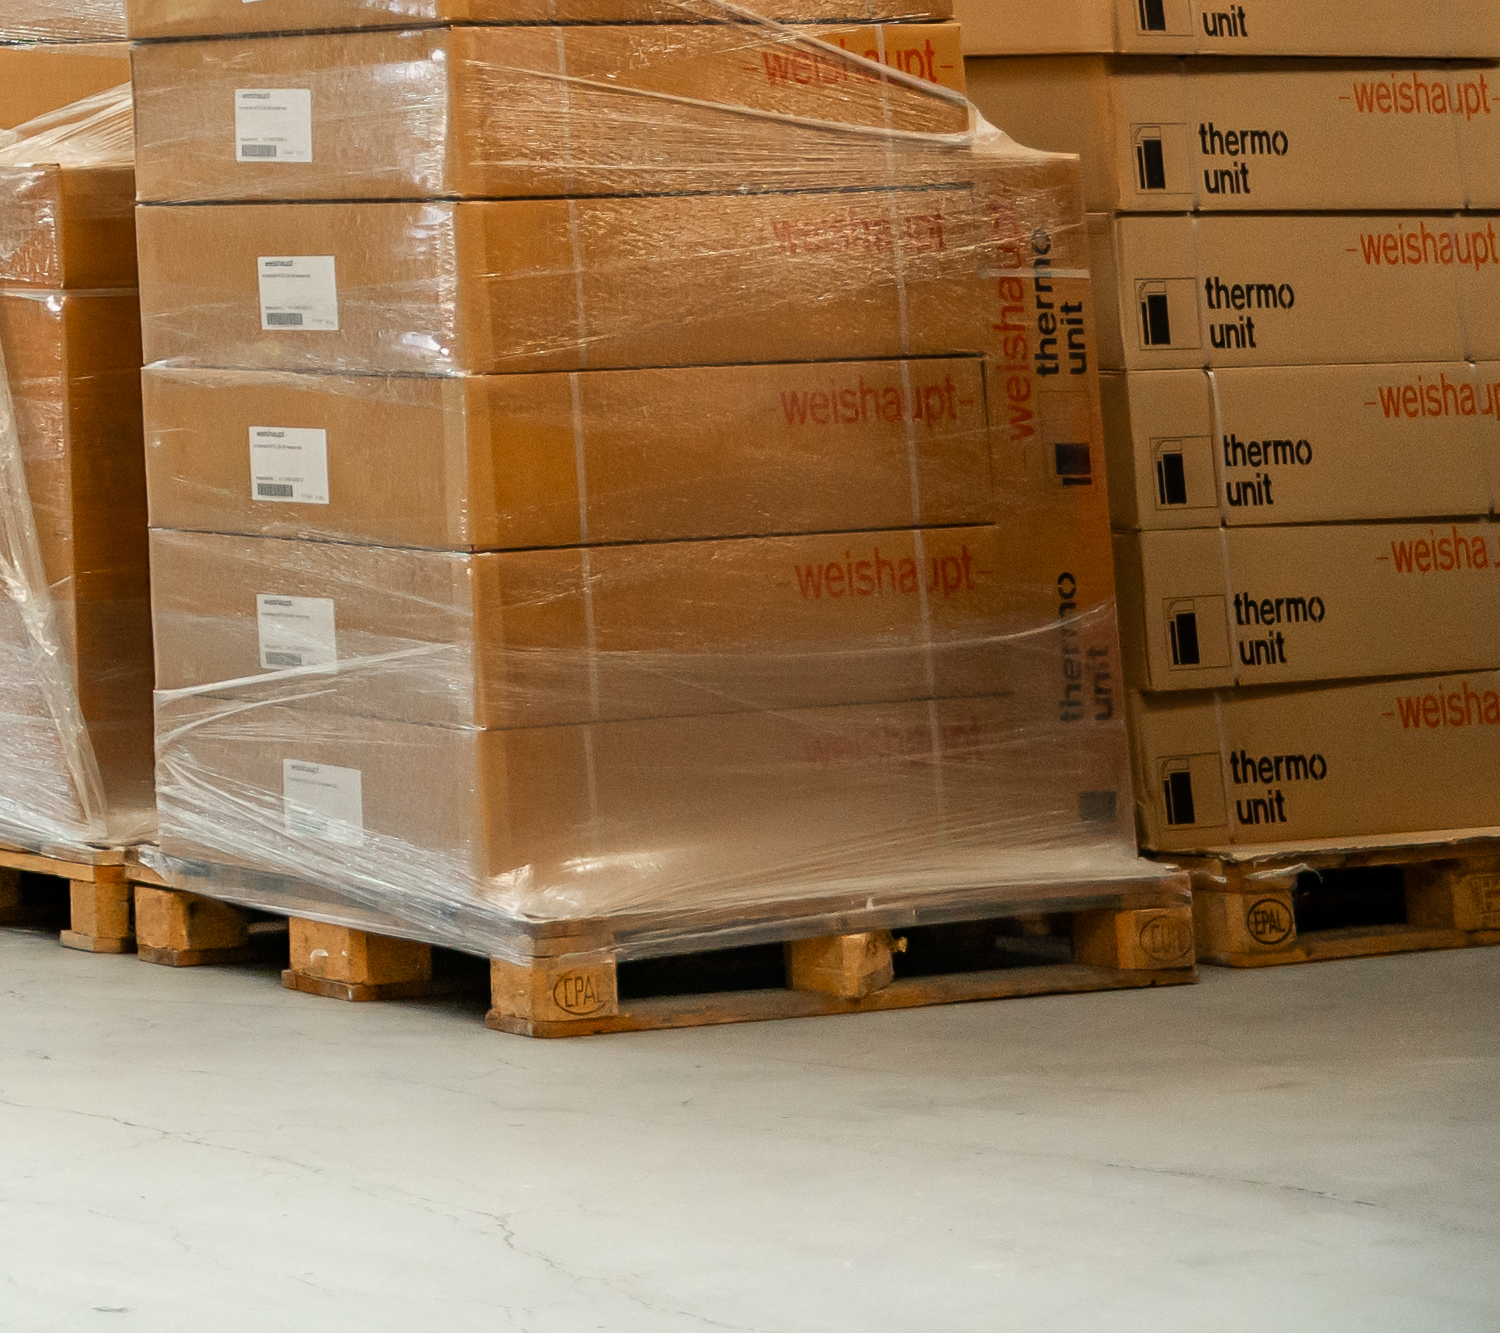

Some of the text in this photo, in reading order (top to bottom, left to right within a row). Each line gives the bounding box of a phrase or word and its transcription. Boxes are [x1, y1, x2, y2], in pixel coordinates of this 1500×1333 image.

[1202, 5, 1249, 38] unit
[1200, 122, 1289, 158] thermo
[1204, 161, 1251, 195] unit
[1032, 229, 1060, 377] thermo
[1205, 277, 1295, 310] thermo
[1066, 299, 1088, 376] unit
[1210, 316, 1257, 350] unit
[1223, 434, 1312, 468] thermo
[1226, 473, 1274, 507] unit
[1234, 592, 1325, 627] thermo
[1056, 571, 1082, 722] thermo
[1239, 630, 1288, 667] unit
[1231, 750, 1328, 786] thermo
[1236, 789, 1288, 827] unit
